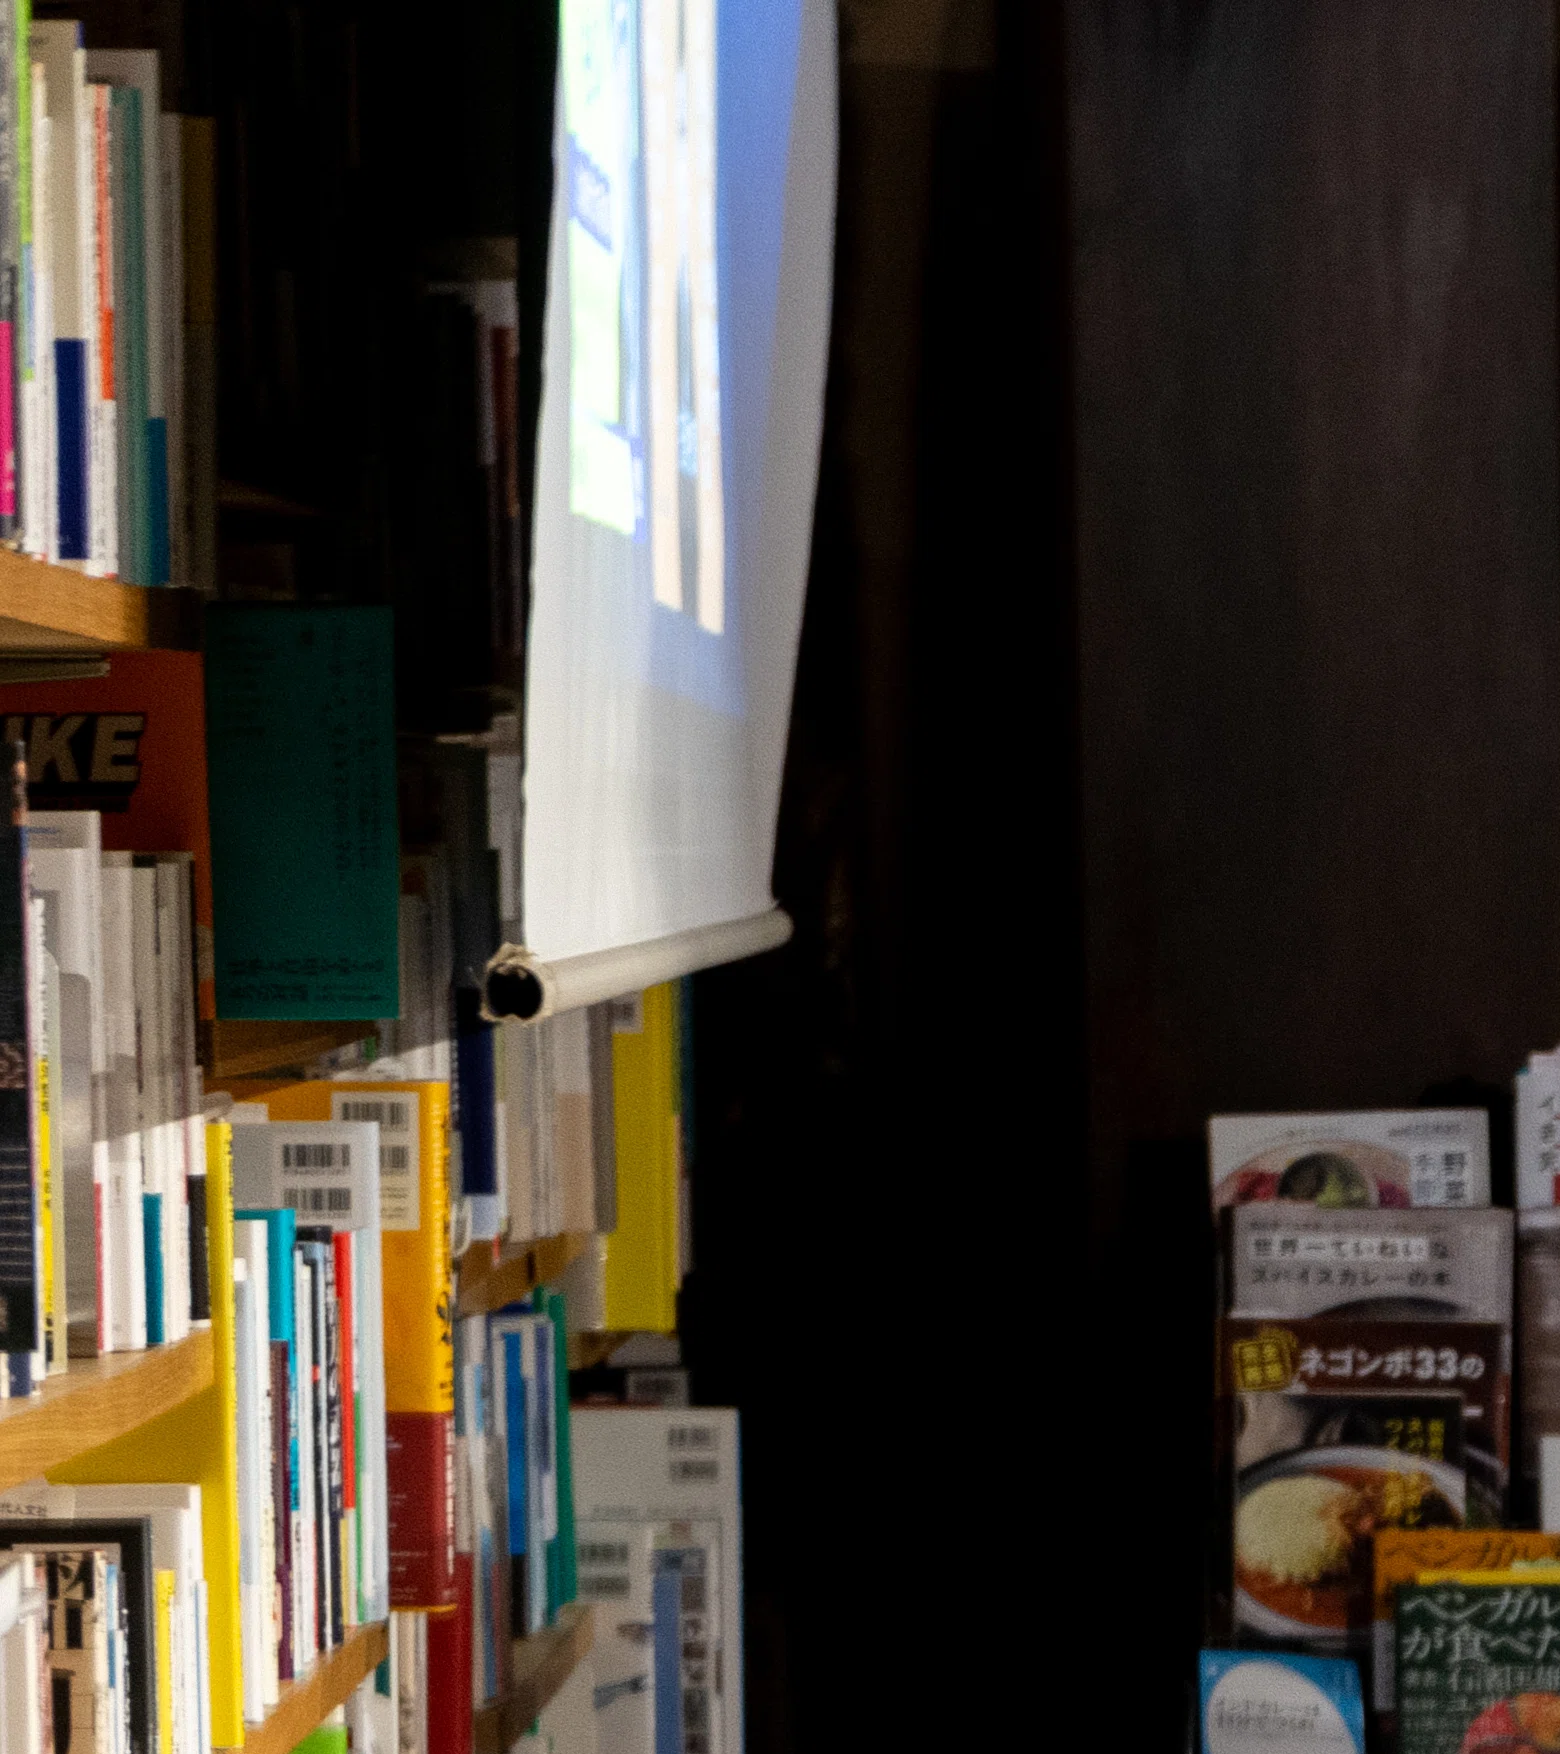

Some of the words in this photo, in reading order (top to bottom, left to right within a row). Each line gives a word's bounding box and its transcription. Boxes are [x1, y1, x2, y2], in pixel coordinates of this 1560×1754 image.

[1300, 1345, 1486, 1381] ネゴンボ33の
